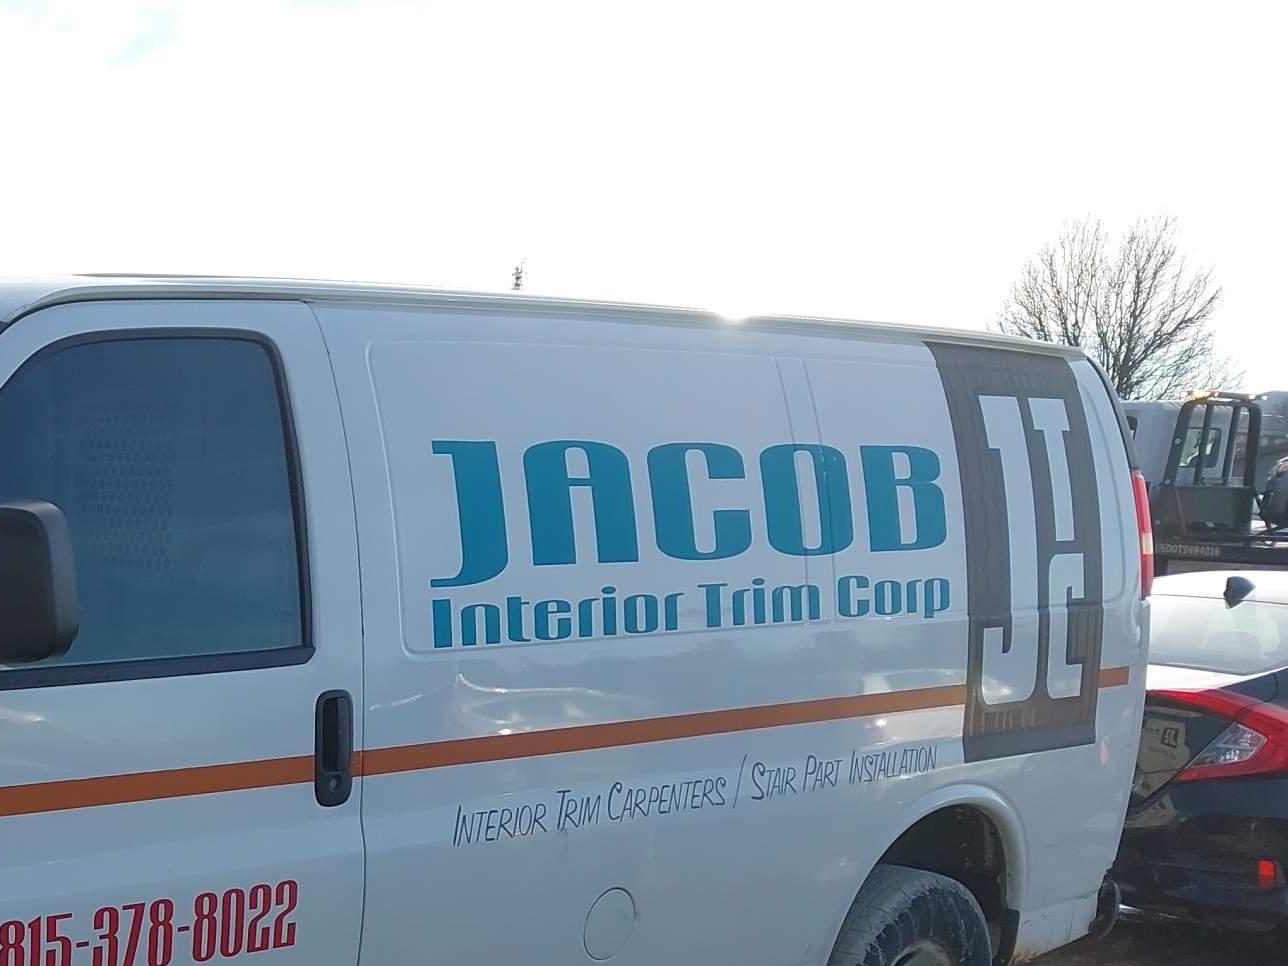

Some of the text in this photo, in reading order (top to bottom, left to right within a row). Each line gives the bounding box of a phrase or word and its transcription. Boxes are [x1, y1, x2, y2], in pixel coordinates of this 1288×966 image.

[430, 439, 948, 588] JACOB
[431, 575, 951, 649] Interior Trim Corp
[452, 804, 548, 847] INTERIOR
[556, 789, 602, 832] TRIM
[607, 776, 727, 822] CARPENTERS
[751, 761, 797, 800] STAIR
[803, 754, 844, 793] PART
[849, 745, 938, 785] INSTALLATION
